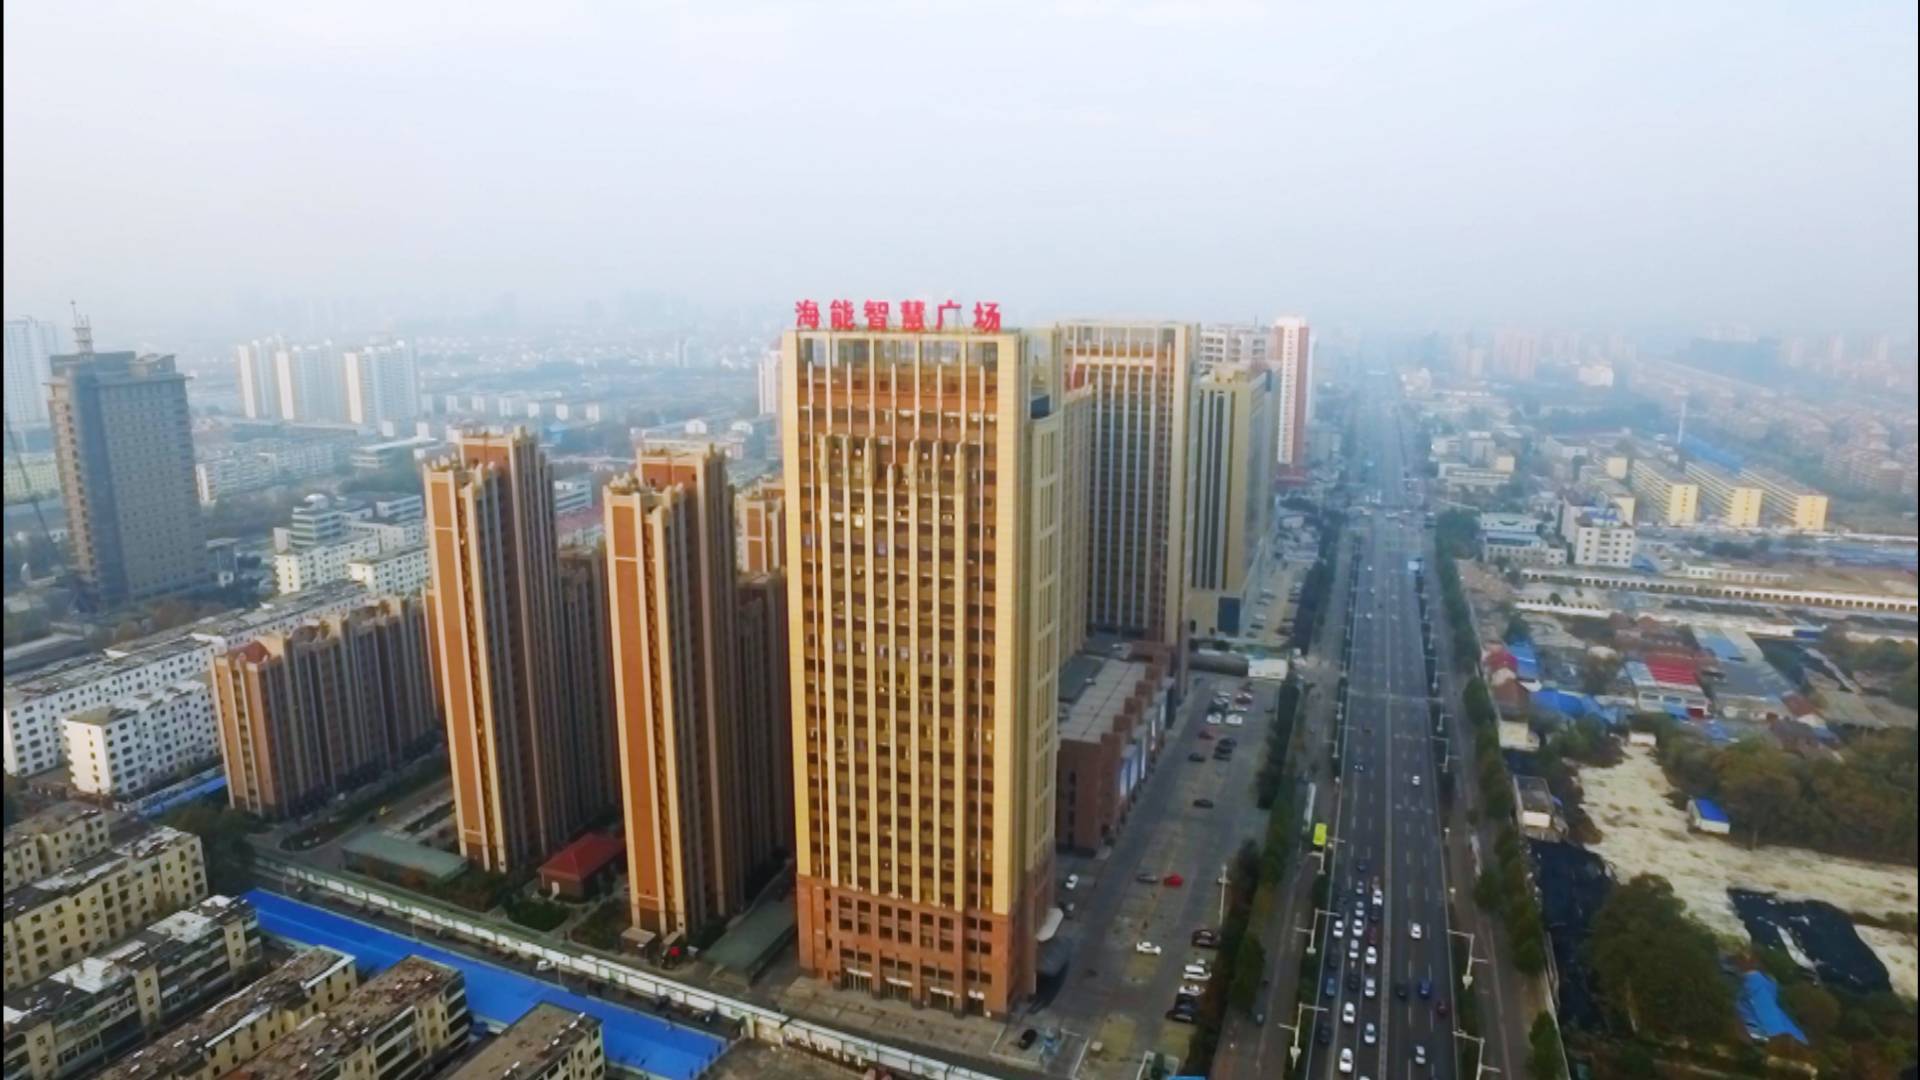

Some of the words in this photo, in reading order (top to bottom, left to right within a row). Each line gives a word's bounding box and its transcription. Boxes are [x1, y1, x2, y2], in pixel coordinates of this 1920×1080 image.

[795, 299, 1002, 333] 海能智慧广场
